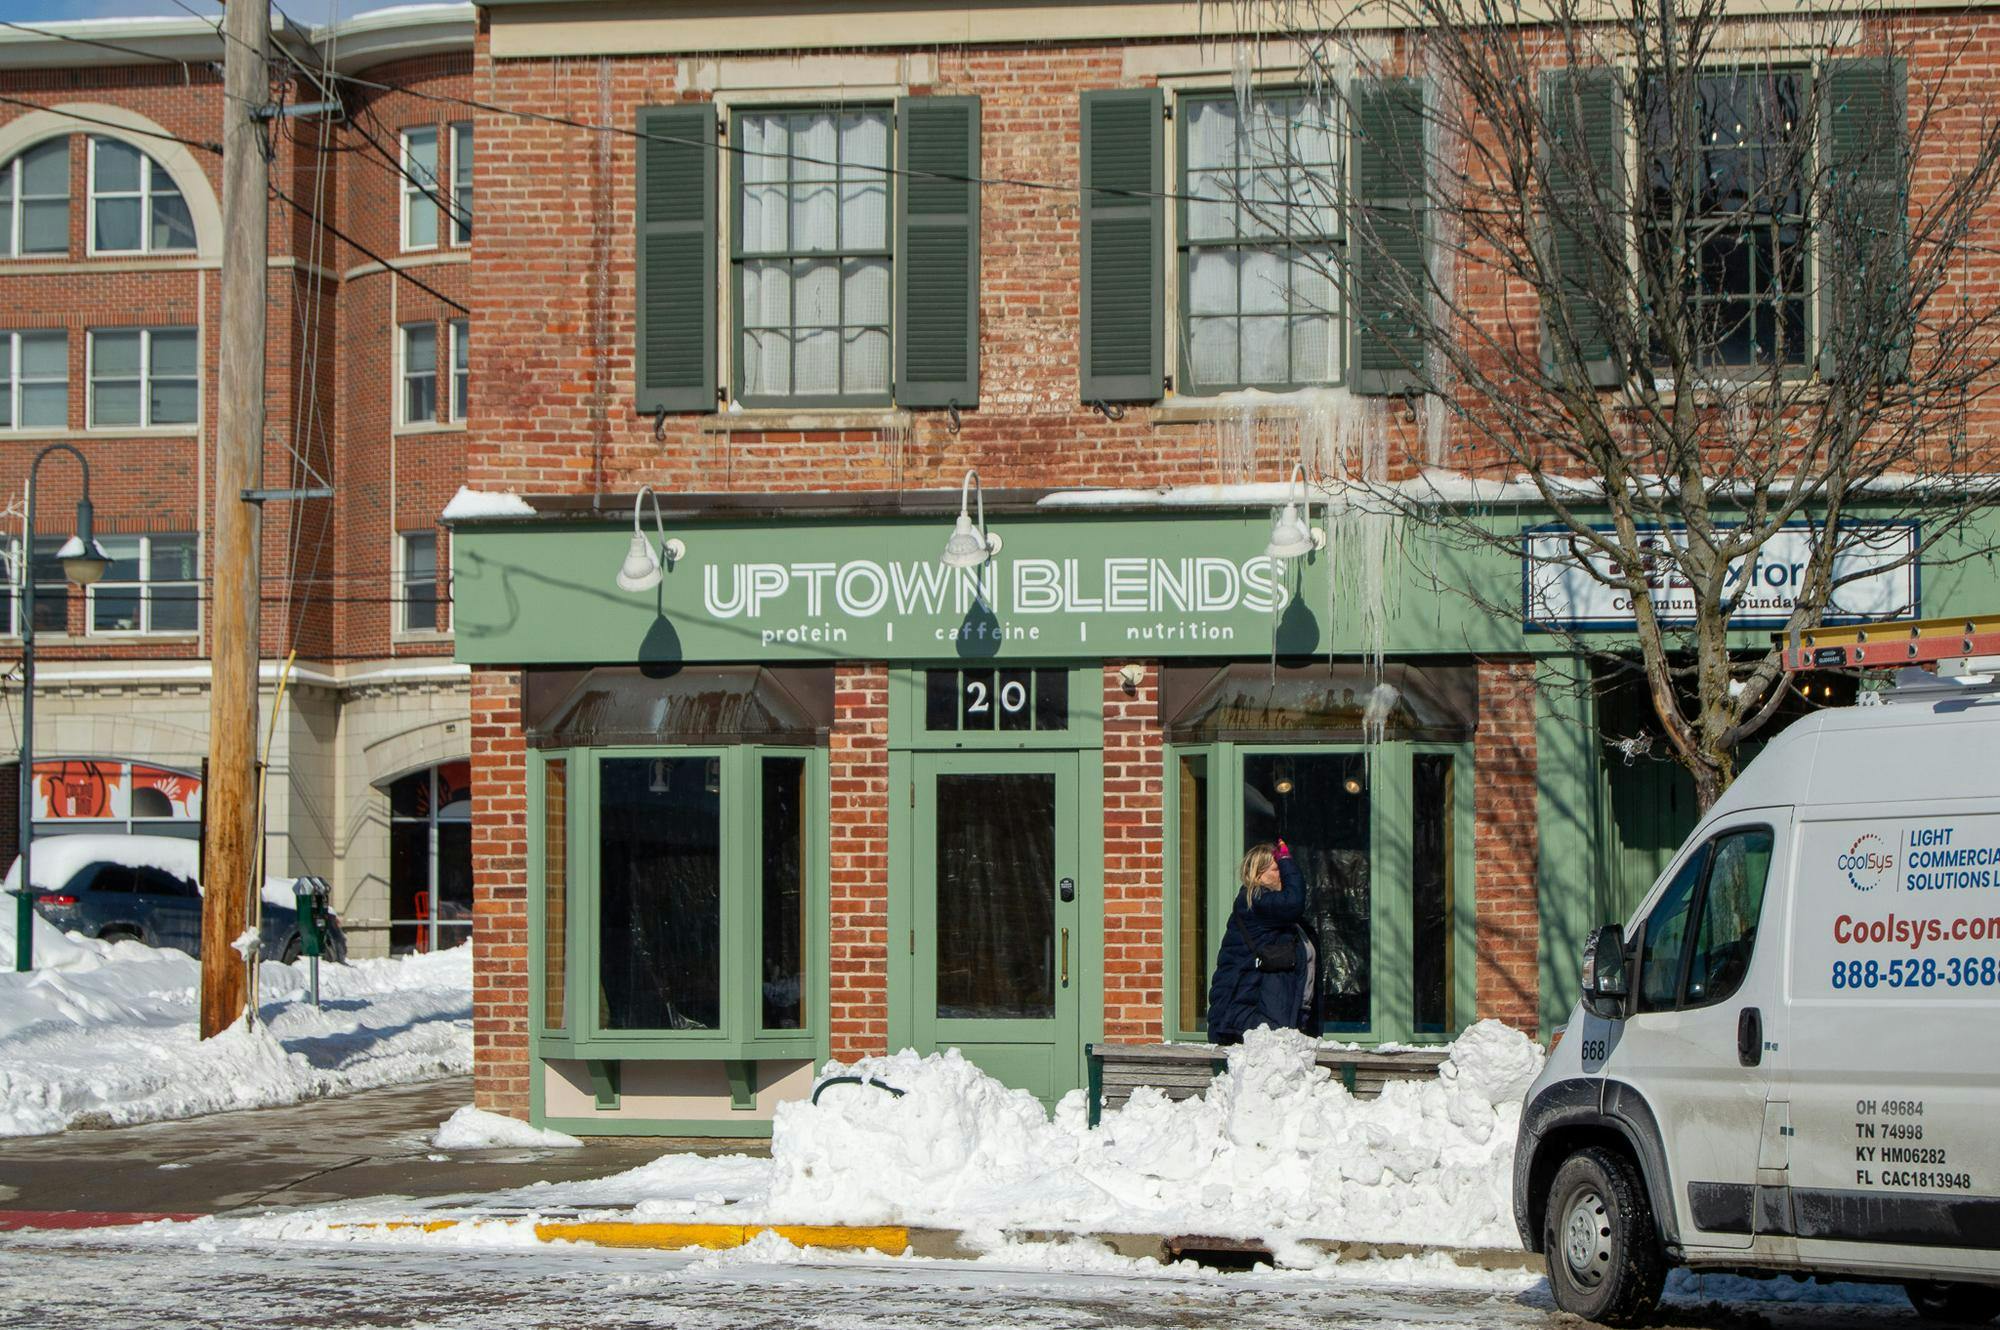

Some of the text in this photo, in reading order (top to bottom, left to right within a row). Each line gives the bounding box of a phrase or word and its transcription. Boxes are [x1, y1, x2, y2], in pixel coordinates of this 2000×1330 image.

[704, 555, 1289, 618] UPTOWN BLENDS
[762, 620, 1234, 647] protein caffeine nutrition
[966, 680, 1026, 712] 20
[1910, 828, 1953, 847] LIGHT
[1838, 853, 1893, 874] CoolSys
[1906, 870, 1990, 891] SOLUTIONS
[1831, 956, 2000, 989] 888-528-368
[1581, 1039, 1605, 1061] 668
[1856, 1100, 1923, 1116] OH 49684
[1855, 1123, 1923, 1140] TN 74998
[1856, 1147, 1946, 1164] KY HM06282
[1856, 1170, 1971, 1189] FL CAC1813948
